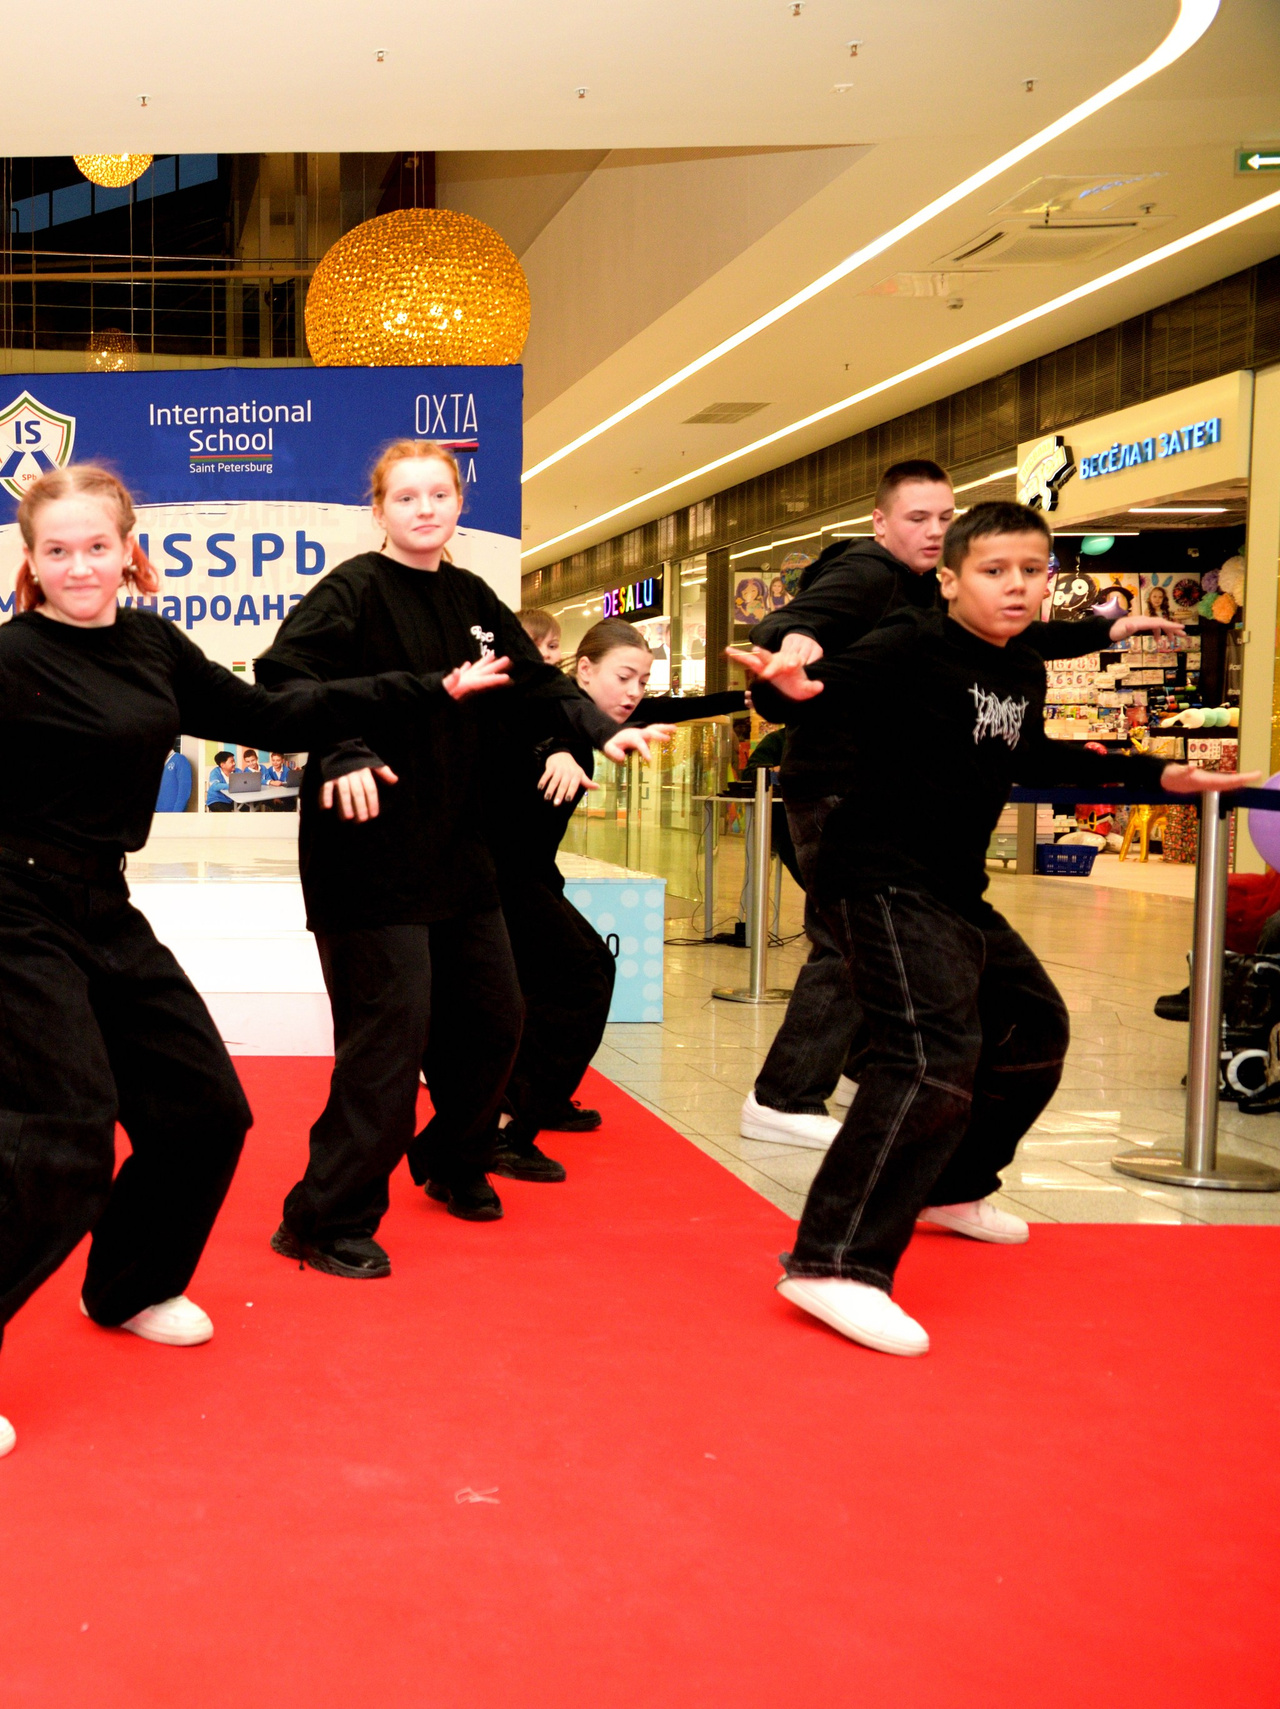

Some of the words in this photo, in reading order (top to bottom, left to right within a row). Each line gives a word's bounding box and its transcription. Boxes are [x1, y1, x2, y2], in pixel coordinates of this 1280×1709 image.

[149, 399, 312, 426] International
[15, 420, 42, 445] IS
[189, 427, 273, 452] School
[1079, 437, 1155, 480] ВЕСЁЛАЯ
[1157, 417, 1220, 458] ЗАТЕЯ
[22, 473, 37, 481] SPb
[189, 463, 216, 473] Saint
[217, 462, 273, 474] Petersburg
[603, 577, 654, 619] DESALU
